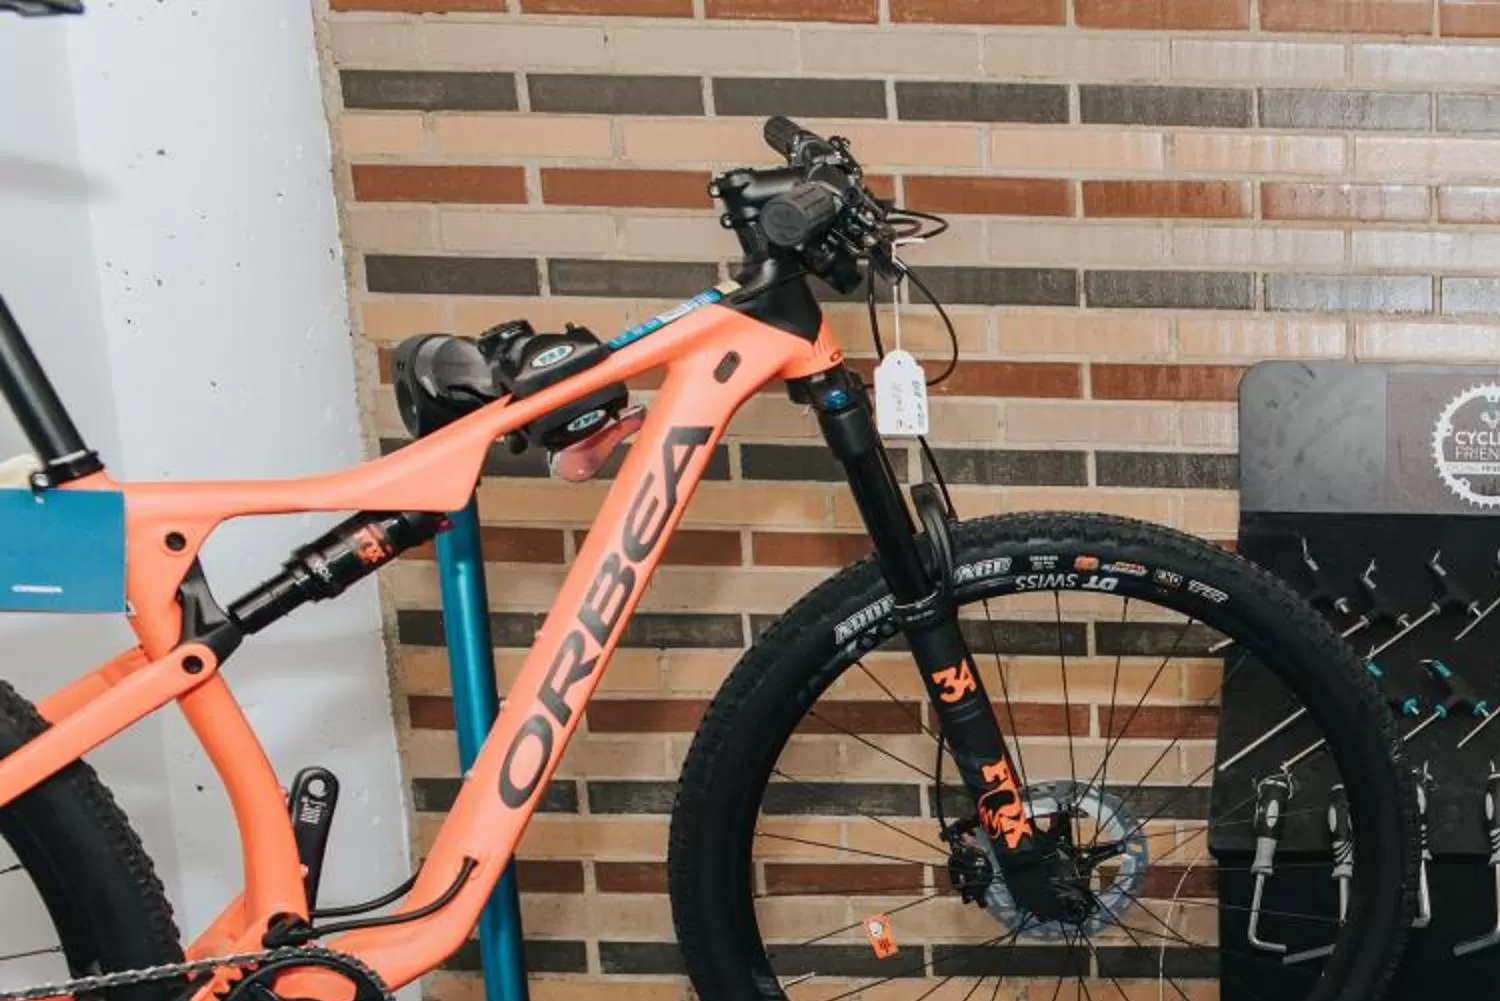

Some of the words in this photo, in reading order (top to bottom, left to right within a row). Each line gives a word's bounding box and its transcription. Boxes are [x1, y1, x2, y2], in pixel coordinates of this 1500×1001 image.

[1014, 571, 1078, 592] SWISS
[498, 426, 715, 809] ORBEA
[930, 658, 977, 703] 34
